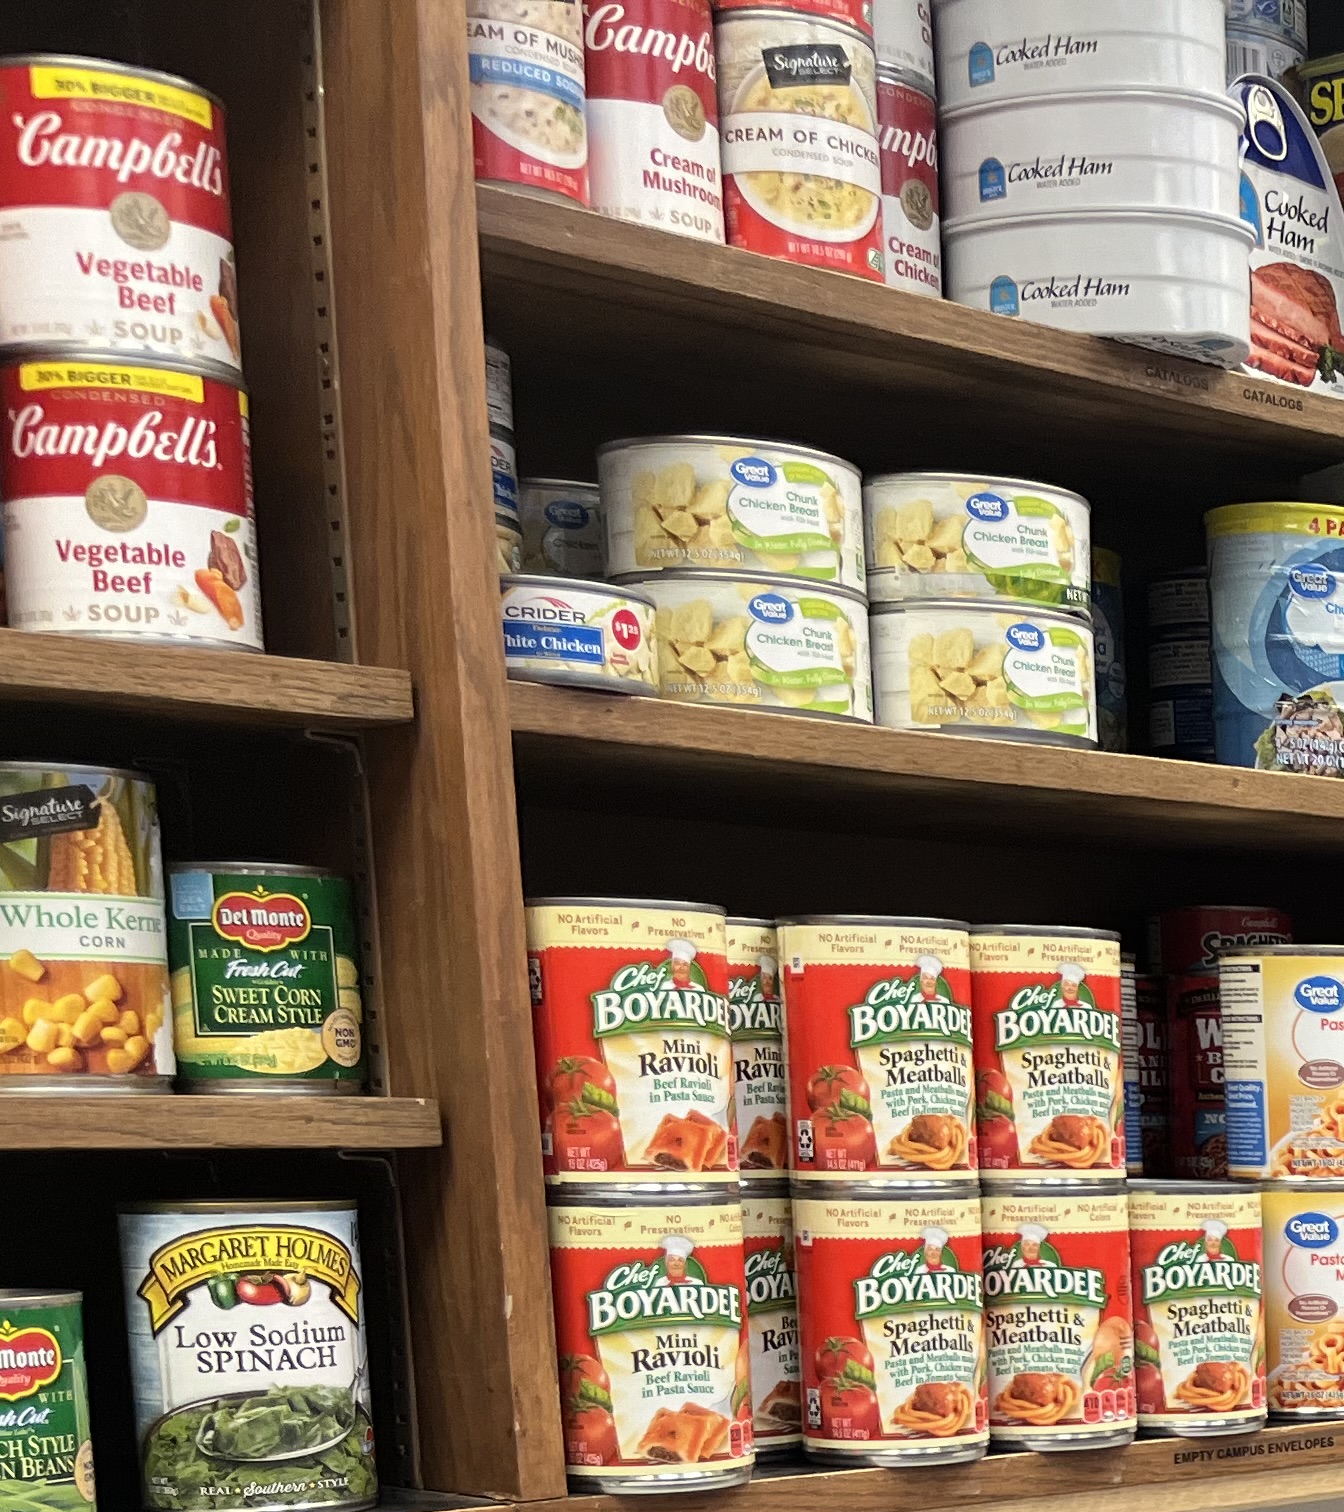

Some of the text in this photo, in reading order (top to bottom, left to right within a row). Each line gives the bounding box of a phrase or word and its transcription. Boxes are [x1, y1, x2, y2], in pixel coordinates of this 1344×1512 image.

[514, 32, 539, 46] OF
[996, 35, 1098, 66] Cooked Ham
[481, 57, 551, 83] REDUCED
[725, 129, 879, 164] CREAM OF CHICKEN
[650, 148, 704, 180] Cream
[1007, 157, 1113, 184] Cooked Ham
[670, 210, 712, 233] SOUP
[1264, 190, 1329, 234] Cooked
[888, 236, 932, 262] Cream
[1267, 223, 1314, 254] Ham
[76, 251, 204, 292] Vegetable
[117, 286, 177, 316] Beef
[114, 320, 184, 346] SOUP
[1243, 388, 1303, 412] CATALOGS
[786, 491, 818, 505] Chunk
[1017, 525, 1048, 537] Chunk
[1309, 518, 1320, 534] 4
[973, 531, 1049, 549] Chicken Breast
[55, 539, 186, 568] Vegetable
[92, 569, 152, 594] Beef
[88, 604, 160, 624] SOUP
[504, 606, 585, 623] CRIDER
[756, 633, 833, 652] Chicken Breast
[802, 627, 832, 641] Chunk
[1, 799, 84, 827] Signature
[31, 811, 83, 826] SELECT
[220, 907, 304, 928] Del Monte
[79, 936, 126, 949] CORN
[572, 925, 609, 936] Flavors
[199, 949, 328, 962] MADE WITH
[616, 965, 666, 990] Chef
[212, 984, 322, 1006] SWEET CORN
[1300, 984, 1338, 998] Great
[1310, 994, 1340, 1006] Value
[215, 1005, 323, 1025] CREAM STYLE
[663, 1040, 701, 1055] Mini
[879, 1045, 967, 1072] Spaghetti &
[639, 1053, 720, 1079] Ravioli
[886, 1062, 966, 1088] Meatballs
[1028, 1066, 1109, 1090] Meatballs
[160, 1235, 349, 1283] MARGARET HOLMES
[1158, 1243, 1200, 1265] Chef
[606, 1263, 659, 1289] Chef
[590, 1286, 741, 1329] BOYARDEE
[175, 1323, 346, 1349] Low Sodium
[656, 1334, 698, 1349] Mini
[890, 1334, 973, 1358] Meatballs
[991, 1326, 1082, 1348] Meatballs
[197, 1345, 338, 1374] SPINACH
[631, 1345, 720, 1374] Ravioli
[28, 1434, 75, 1457] STYLE
[1174, 1437, 1335, 1465] EMPTY CAMPUS ENVELOPES
[200, 1476, 349, 1499] REAL Southern STYLE
